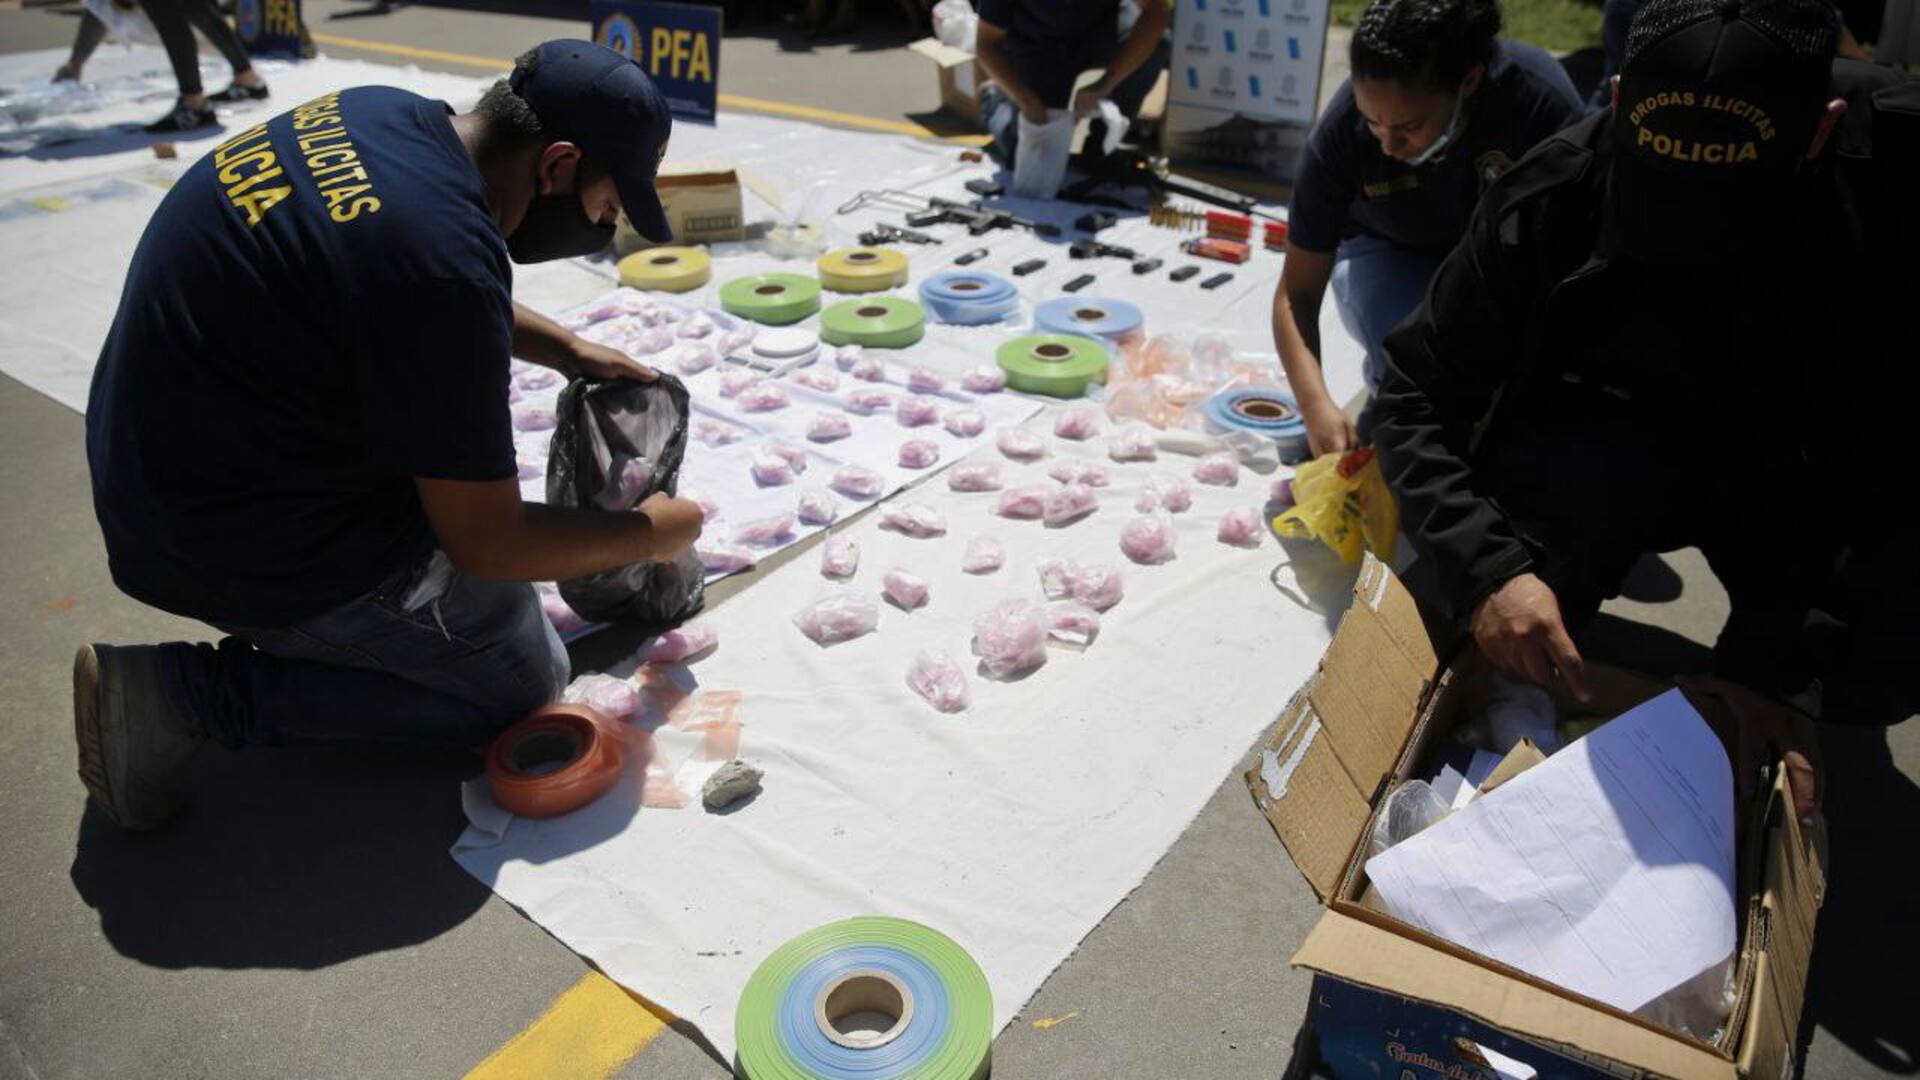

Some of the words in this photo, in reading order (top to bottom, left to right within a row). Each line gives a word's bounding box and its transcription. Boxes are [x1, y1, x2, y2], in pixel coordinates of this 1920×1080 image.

[651, 28, 712, 83] PFA
[1630, 92, 1695, 126] DROGAS
[1701, 95, 1775, 141] ILICITAS
[1638, 127, 1757, 163] POLICIA
[297, 126, 381, 222] ILICITAS
